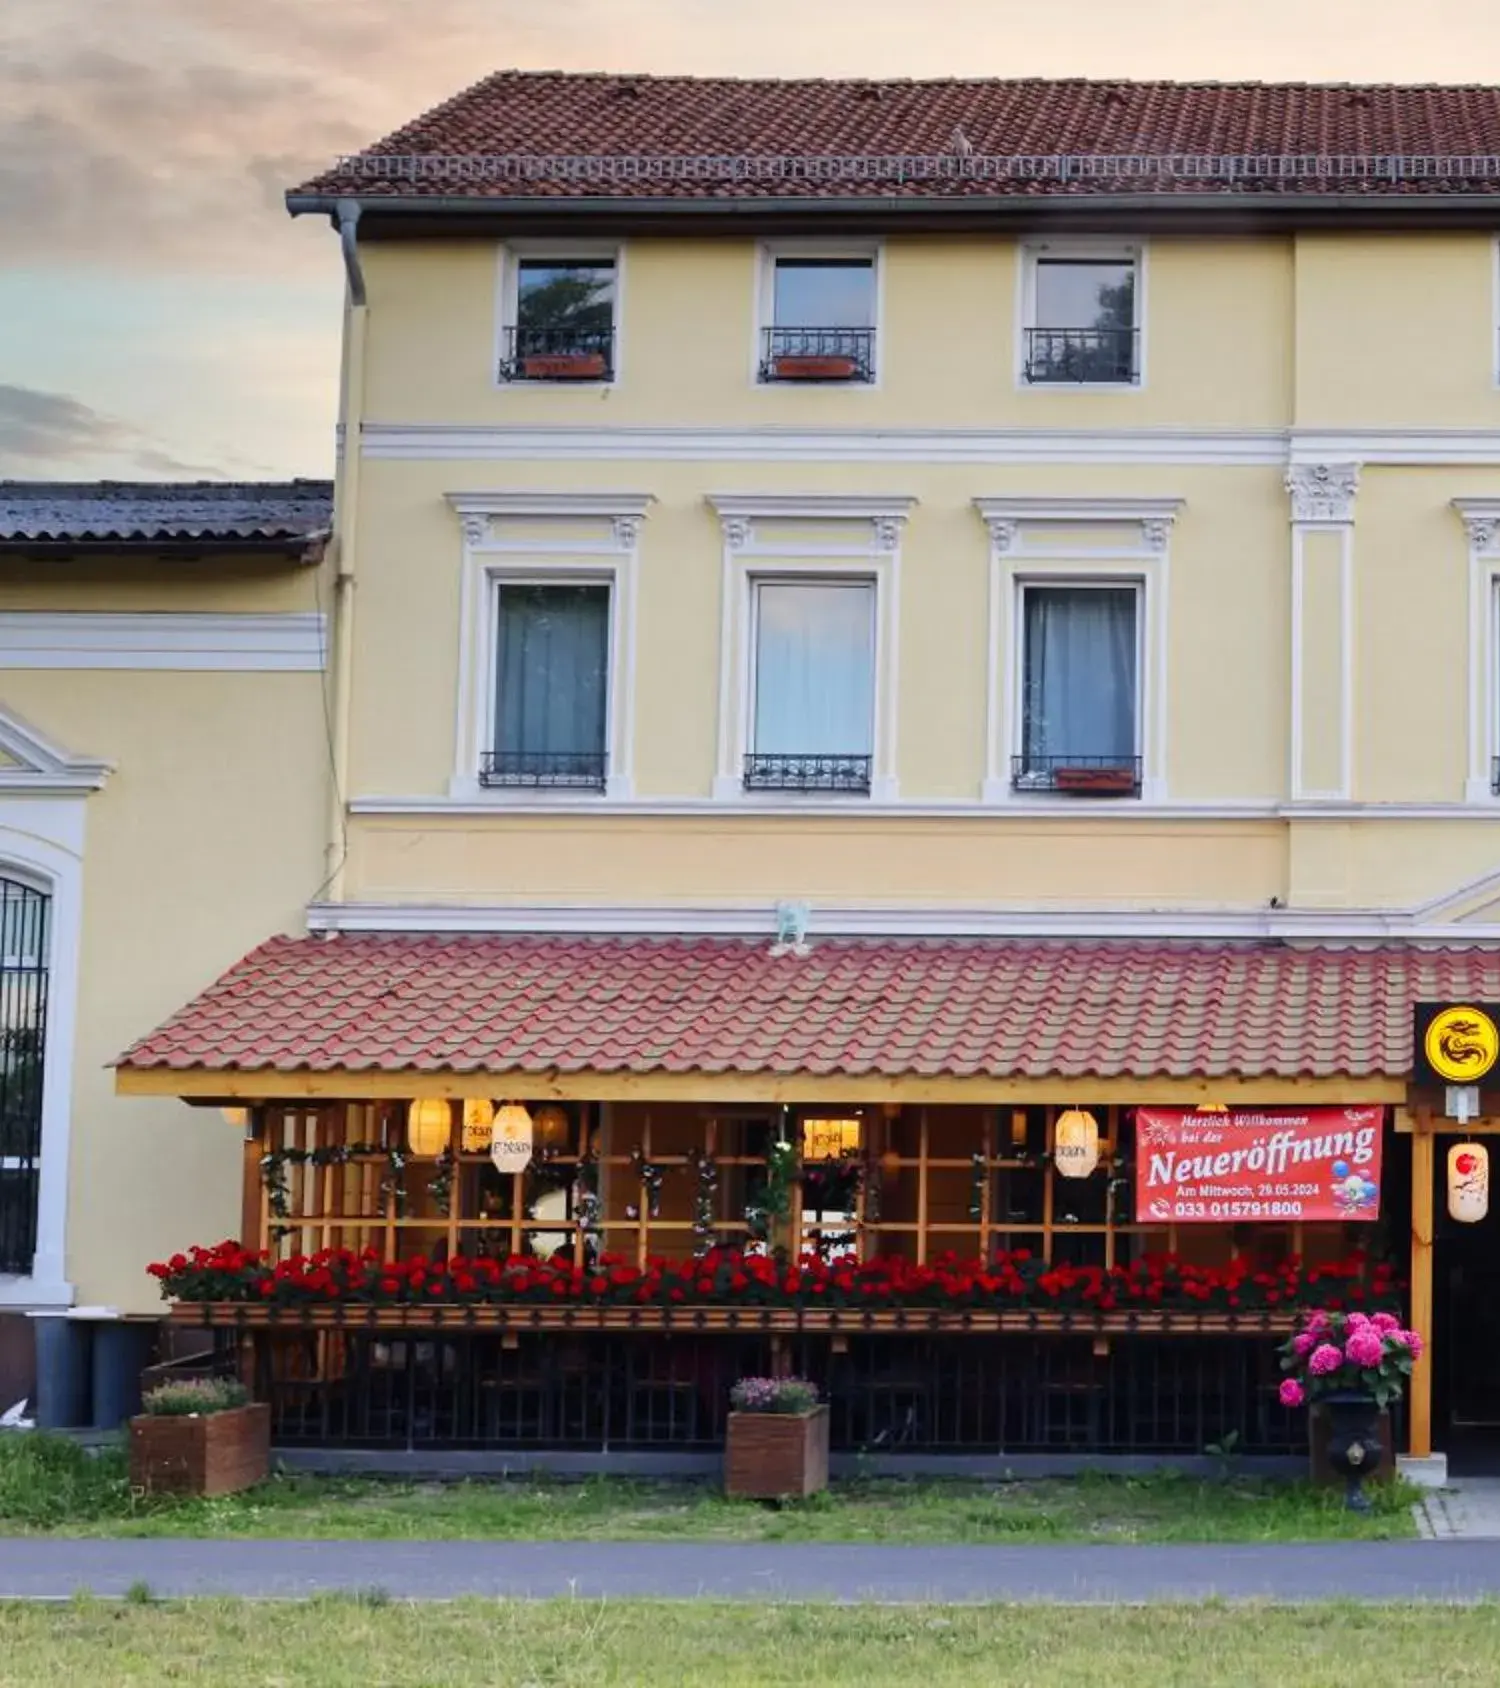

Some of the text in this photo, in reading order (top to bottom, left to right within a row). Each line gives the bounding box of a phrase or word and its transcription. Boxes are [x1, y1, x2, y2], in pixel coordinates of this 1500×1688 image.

[1181, 1113, 1309, 1127] Herzlich Willkommen
[1181, 1131, 1223, 1143] bei der
[1148, 1128, 1376, 1186] Neueröffnung
[1176, 1184, 1197, 1197] Am
[1199, 1184, 1254, 1198] Mittwoch,
[1175, 1201, 1302, 1216] 033 015791800
